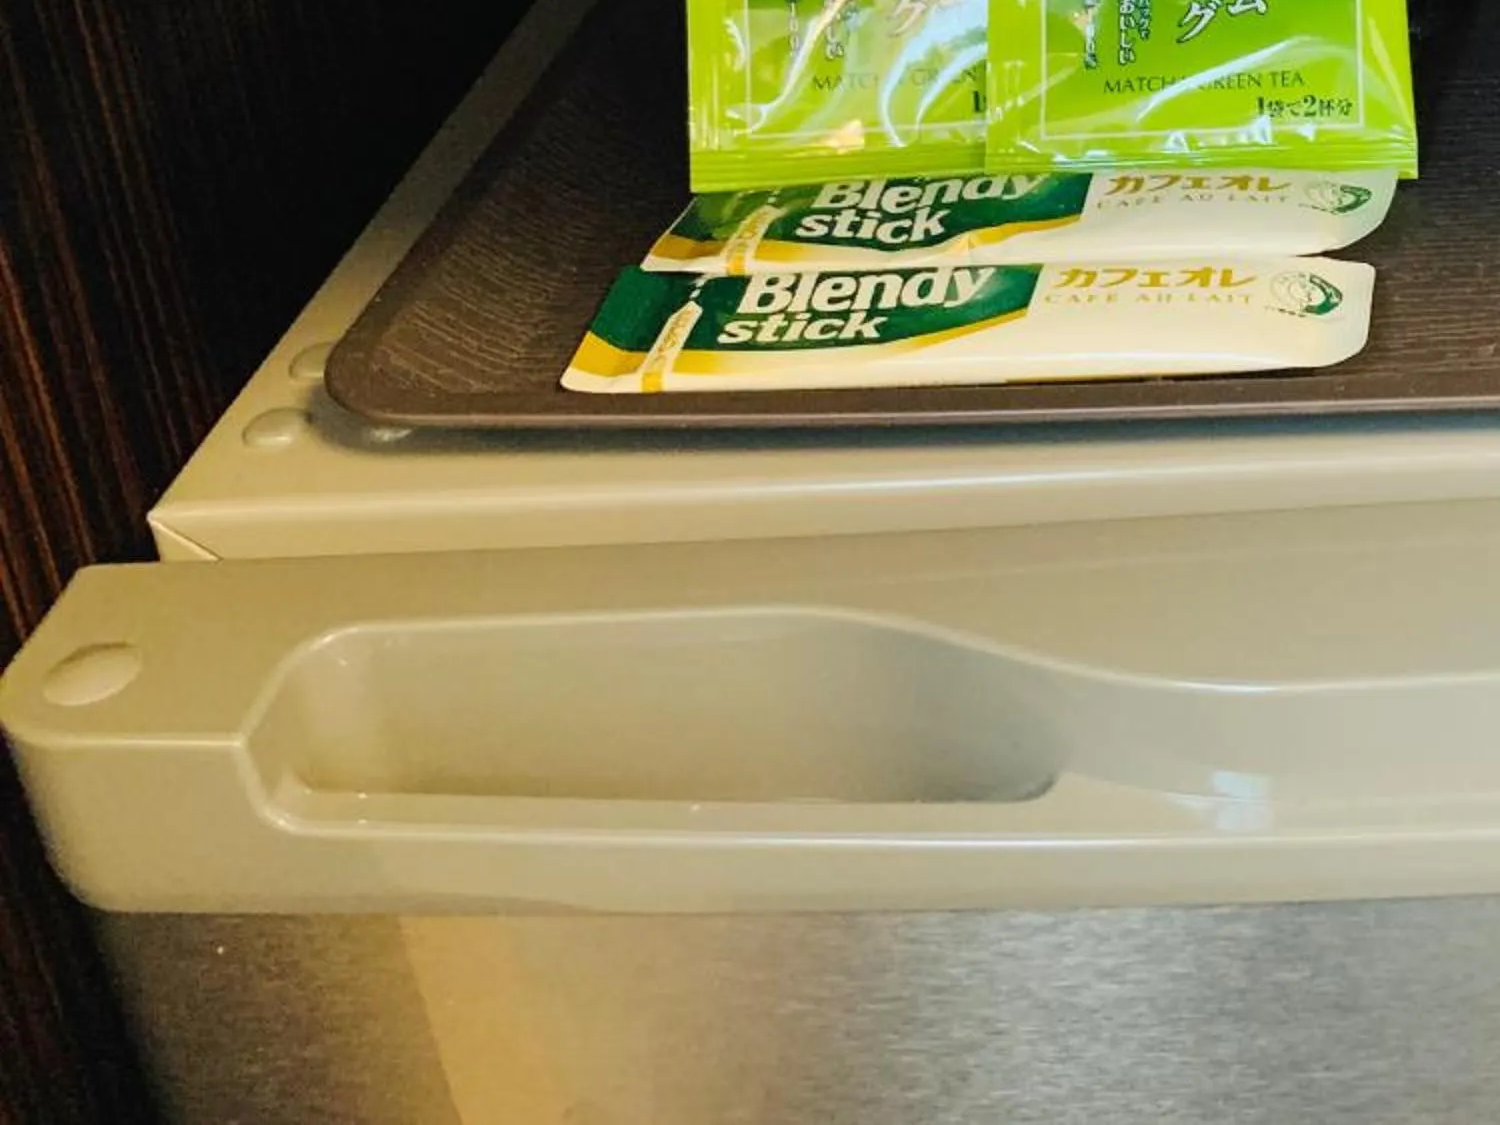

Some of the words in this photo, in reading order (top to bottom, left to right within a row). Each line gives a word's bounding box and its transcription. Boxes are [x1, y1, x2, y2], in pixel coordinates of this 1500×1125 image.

[1271, 71, 1306, 89] TEA
[1105, 174, 1292, 196] カフェオレ
[795, 205, 952, 245] stick
[735, 265, 1001, 315] Blendy
[1053, 266, 1258, 289] カフェオレ
[717, 309, 890, 345] stick
